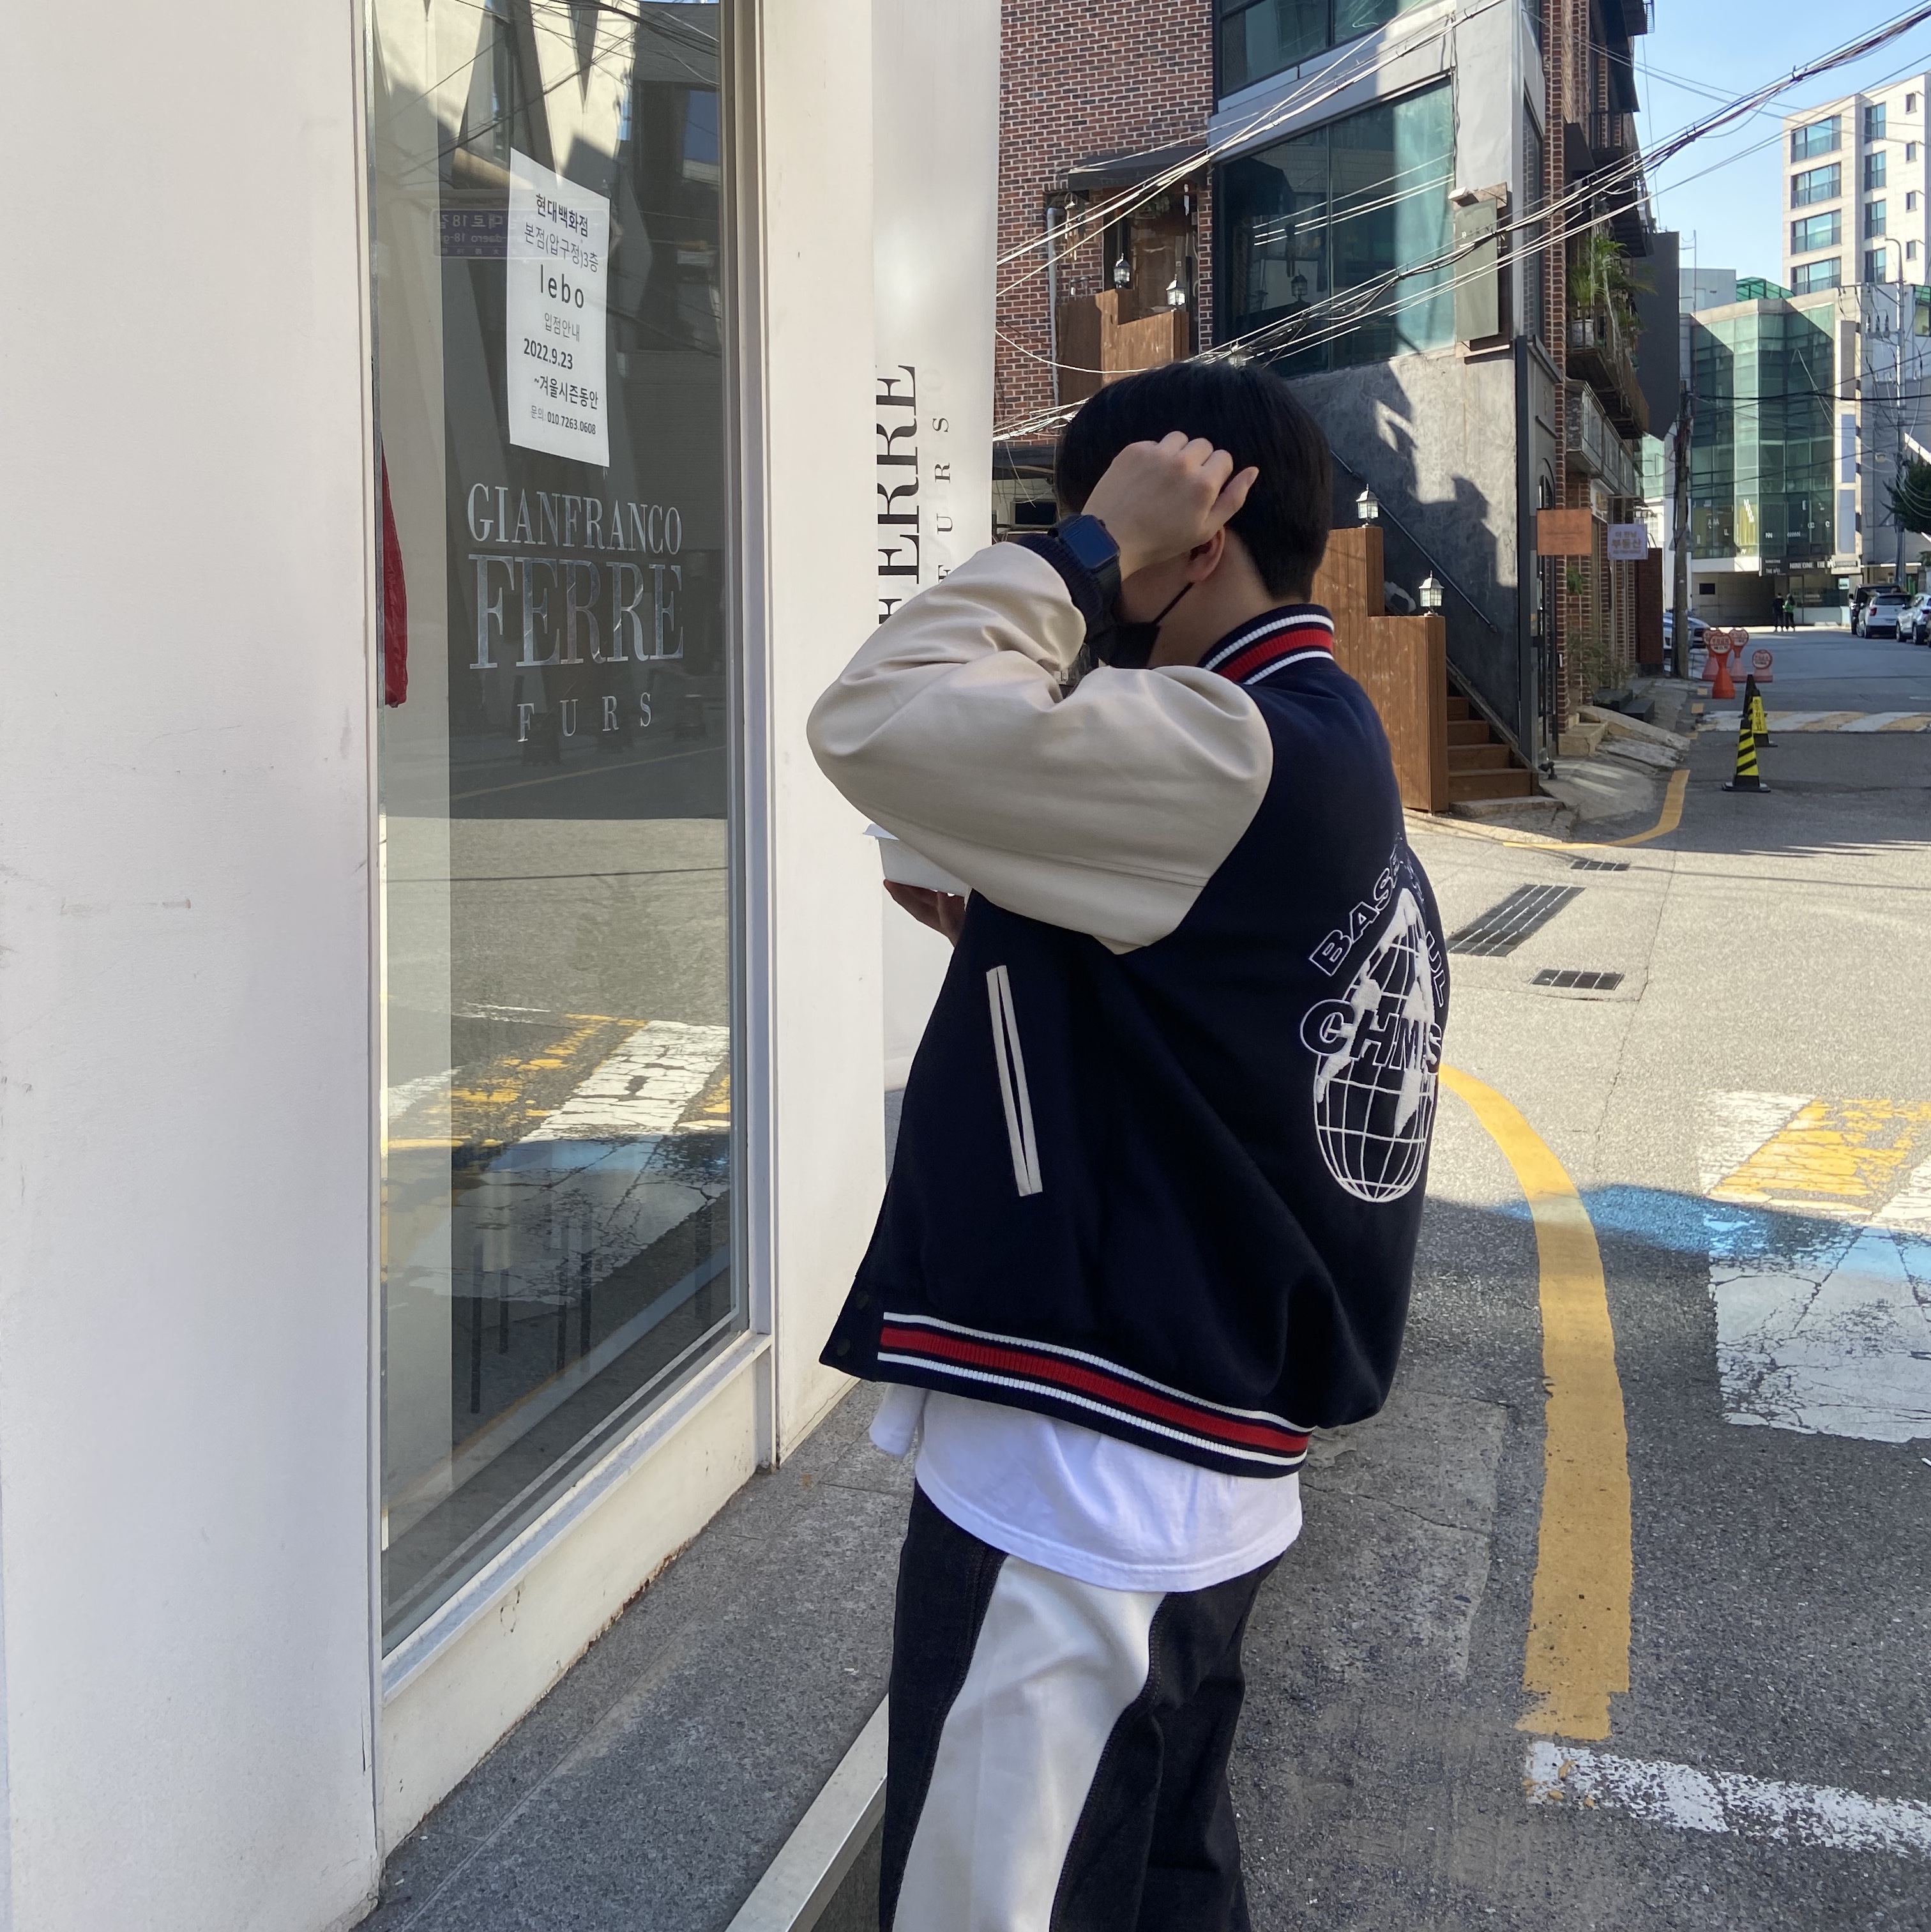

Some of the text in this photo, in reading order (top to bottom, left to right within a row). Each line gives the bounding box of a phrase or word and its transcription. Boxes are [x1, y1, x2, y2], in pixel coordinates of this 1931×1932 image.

[536, 193, 588, 238] 현대백화점
[524, 222, 598, 273] 본점(압구정)3층
[540, 264, 584, 308] lebo
[544, 312, 580, 342] 입점안내
[524, 338, 573, 370] 2022.9.23
[534, 376, 599, 410] ~겨울시즌동안
[467, 483, 683, 555] GIANFRANCO
[1611, 538, 1641, 549] 부동산
[468, 554, 685, 669] FERRE
[517, 692, 652, 742] FURS
